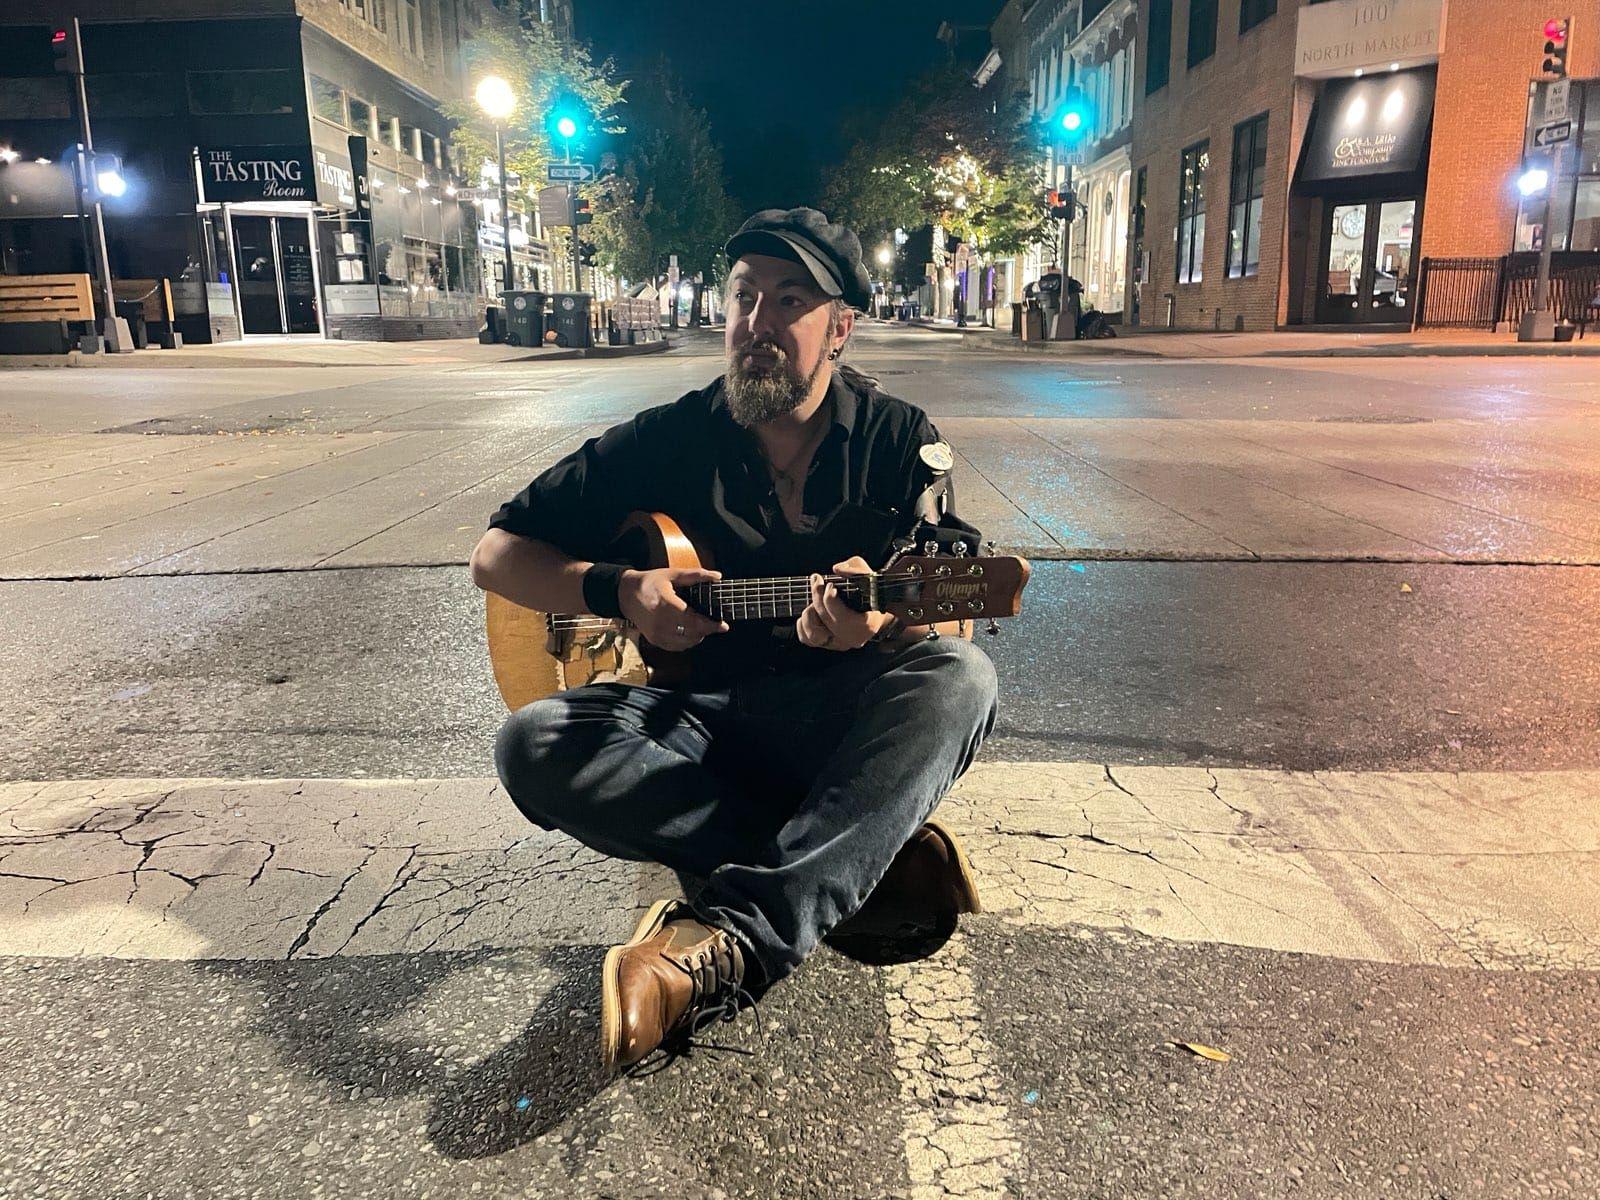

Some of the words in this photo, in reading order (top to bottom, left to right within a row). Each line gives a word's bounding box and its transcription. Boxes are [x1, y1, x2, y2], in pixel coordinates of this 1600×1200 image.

[1353, 4, 1388, 27] 100
[1302, 41, 1354, 62] NORTH
[1365, 29, 1435, 53] MARKET
[208, 151, 232, 161] THE
[209, 160, 301, 181] TASTING
[317, 161, 352, 190] TASTING
[263, 181, 306, 197] Room
